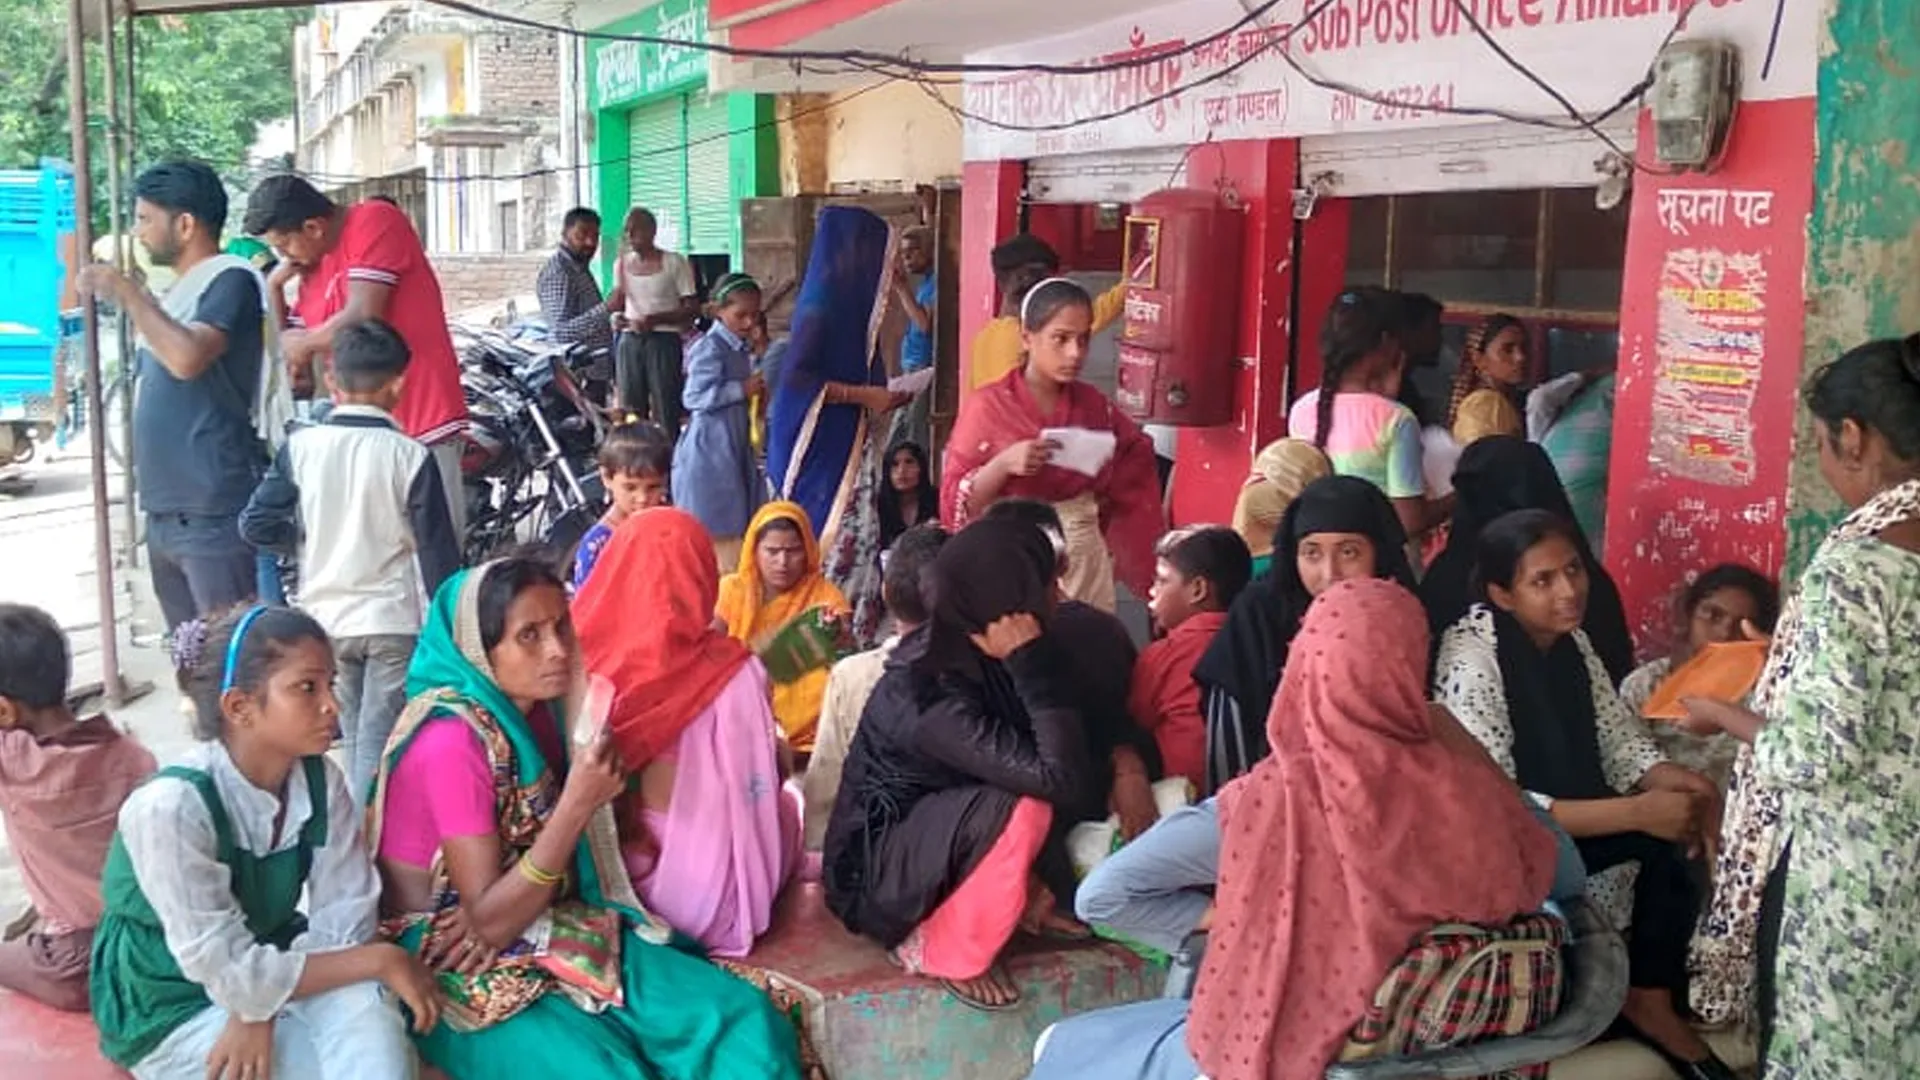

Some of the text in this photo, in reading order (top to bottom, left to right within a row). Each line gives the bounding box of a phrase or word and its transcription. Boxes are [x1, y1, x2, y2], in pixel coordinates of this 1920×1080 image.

[1303, 0, 1351, 53] Sub
[1657, 188, 1775, 236] सूचना पट
